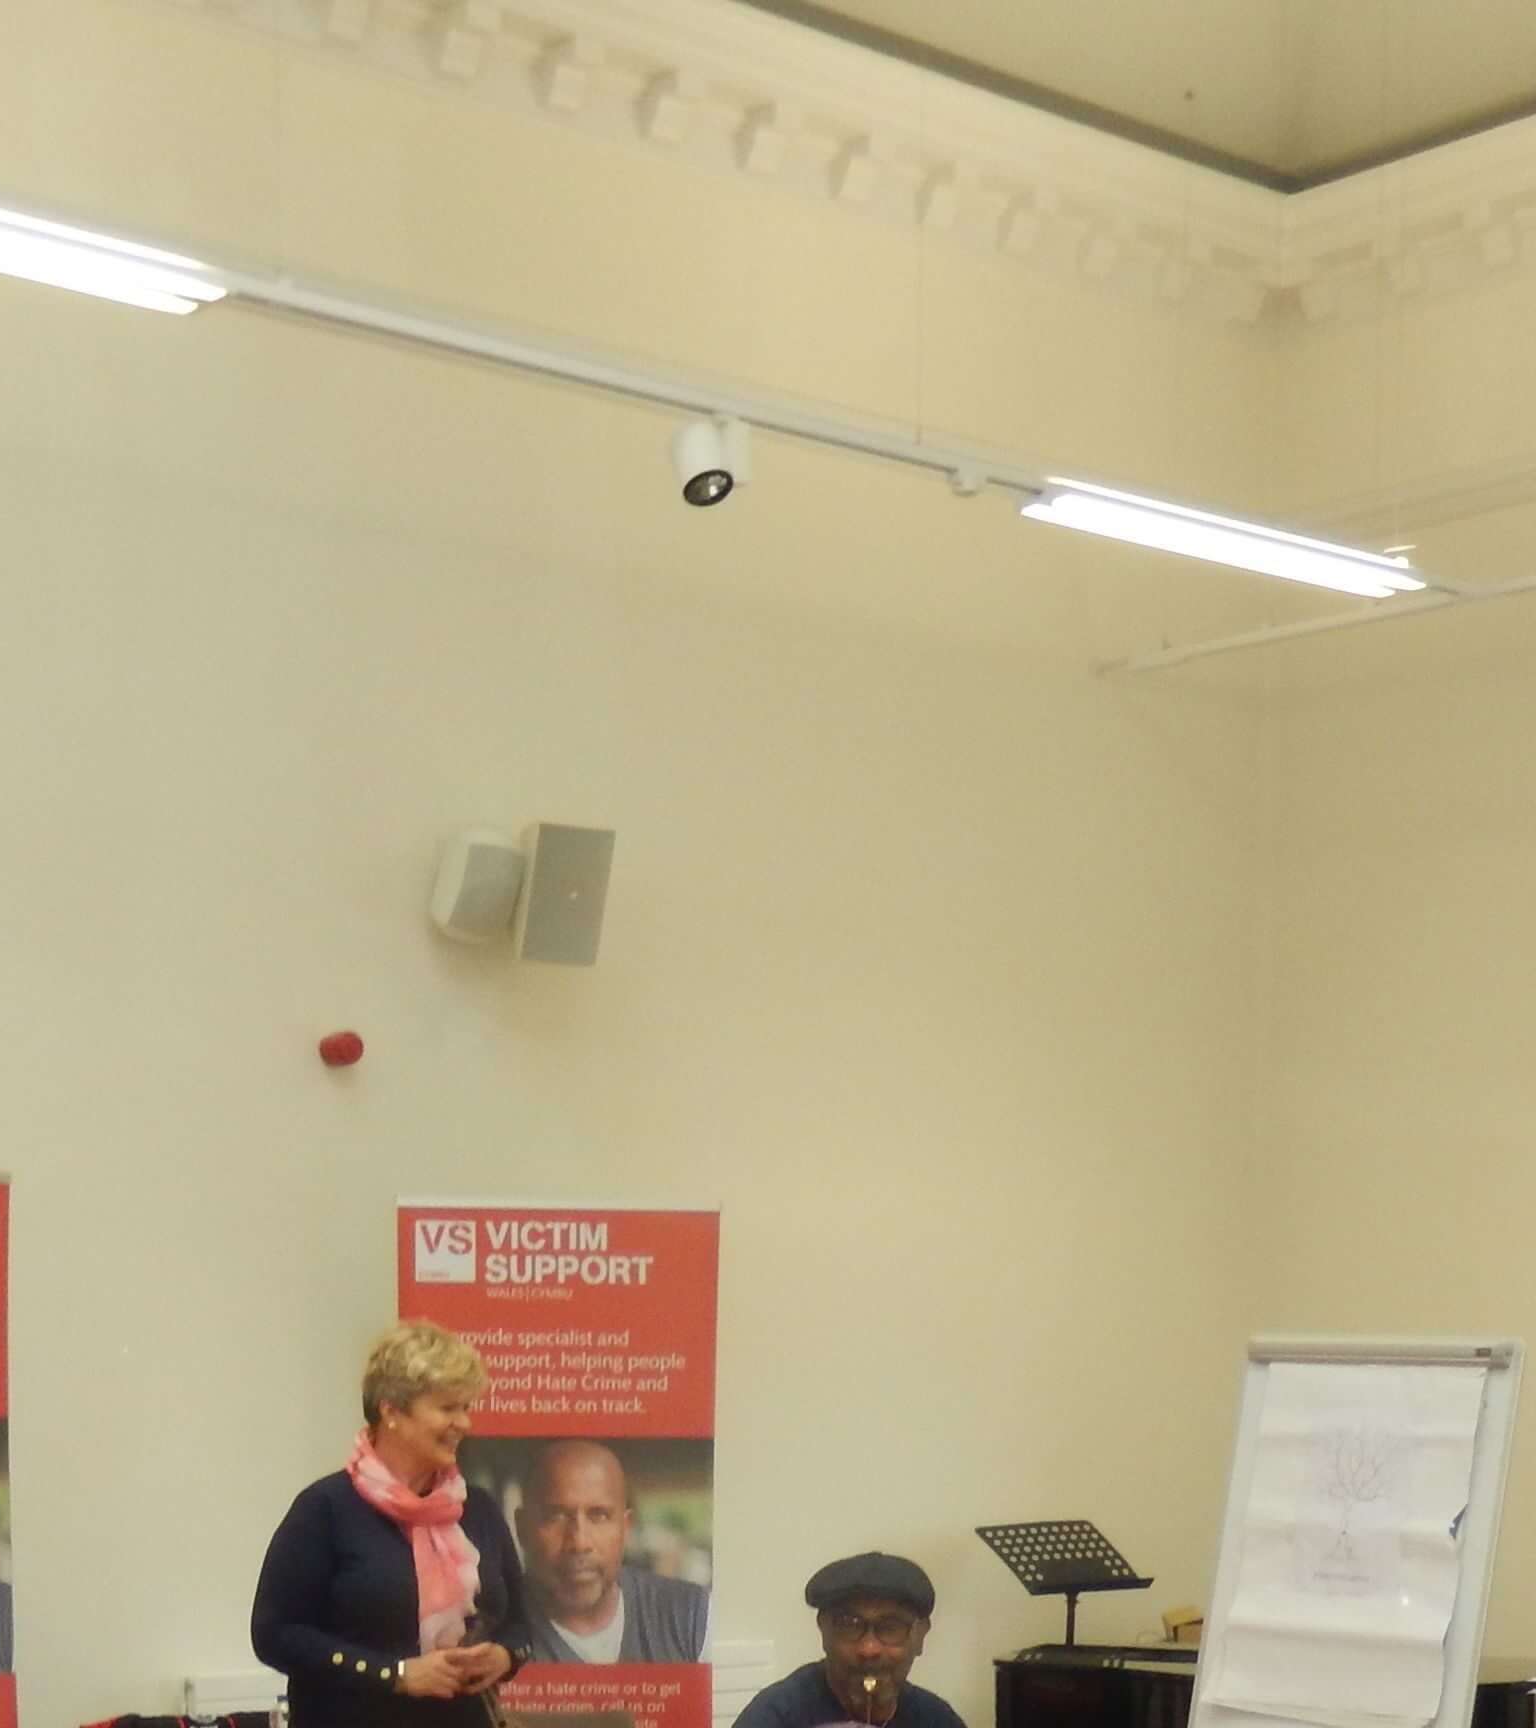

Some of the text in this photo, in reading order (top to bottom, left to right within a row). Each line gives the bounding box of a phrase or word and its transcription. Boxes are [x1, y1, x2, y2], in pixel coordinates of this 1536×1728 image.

[420, 1224, 473, 1255] VS
[485, 1221, 608, 1250] VICTIM
[485, 1254, 654, 1285] SUPPORT
[518, 1329, 595, 1349] specialist
[597, 1331, 629, 1346] and
[487, 1352, 685, 1374] support, helping people
[489, 1375, 668, 1393] yond Hate Crime and
[490, 1396, 527, 1413] lives
[532, 1396, 572, 1413] back
[576, 1400, 597, 1413] on
[602, 1398, 646, 1414] track.
[500, 1682, 681, 1699] after a hate crime or to get
[648, 1702, 665, 1713] on
